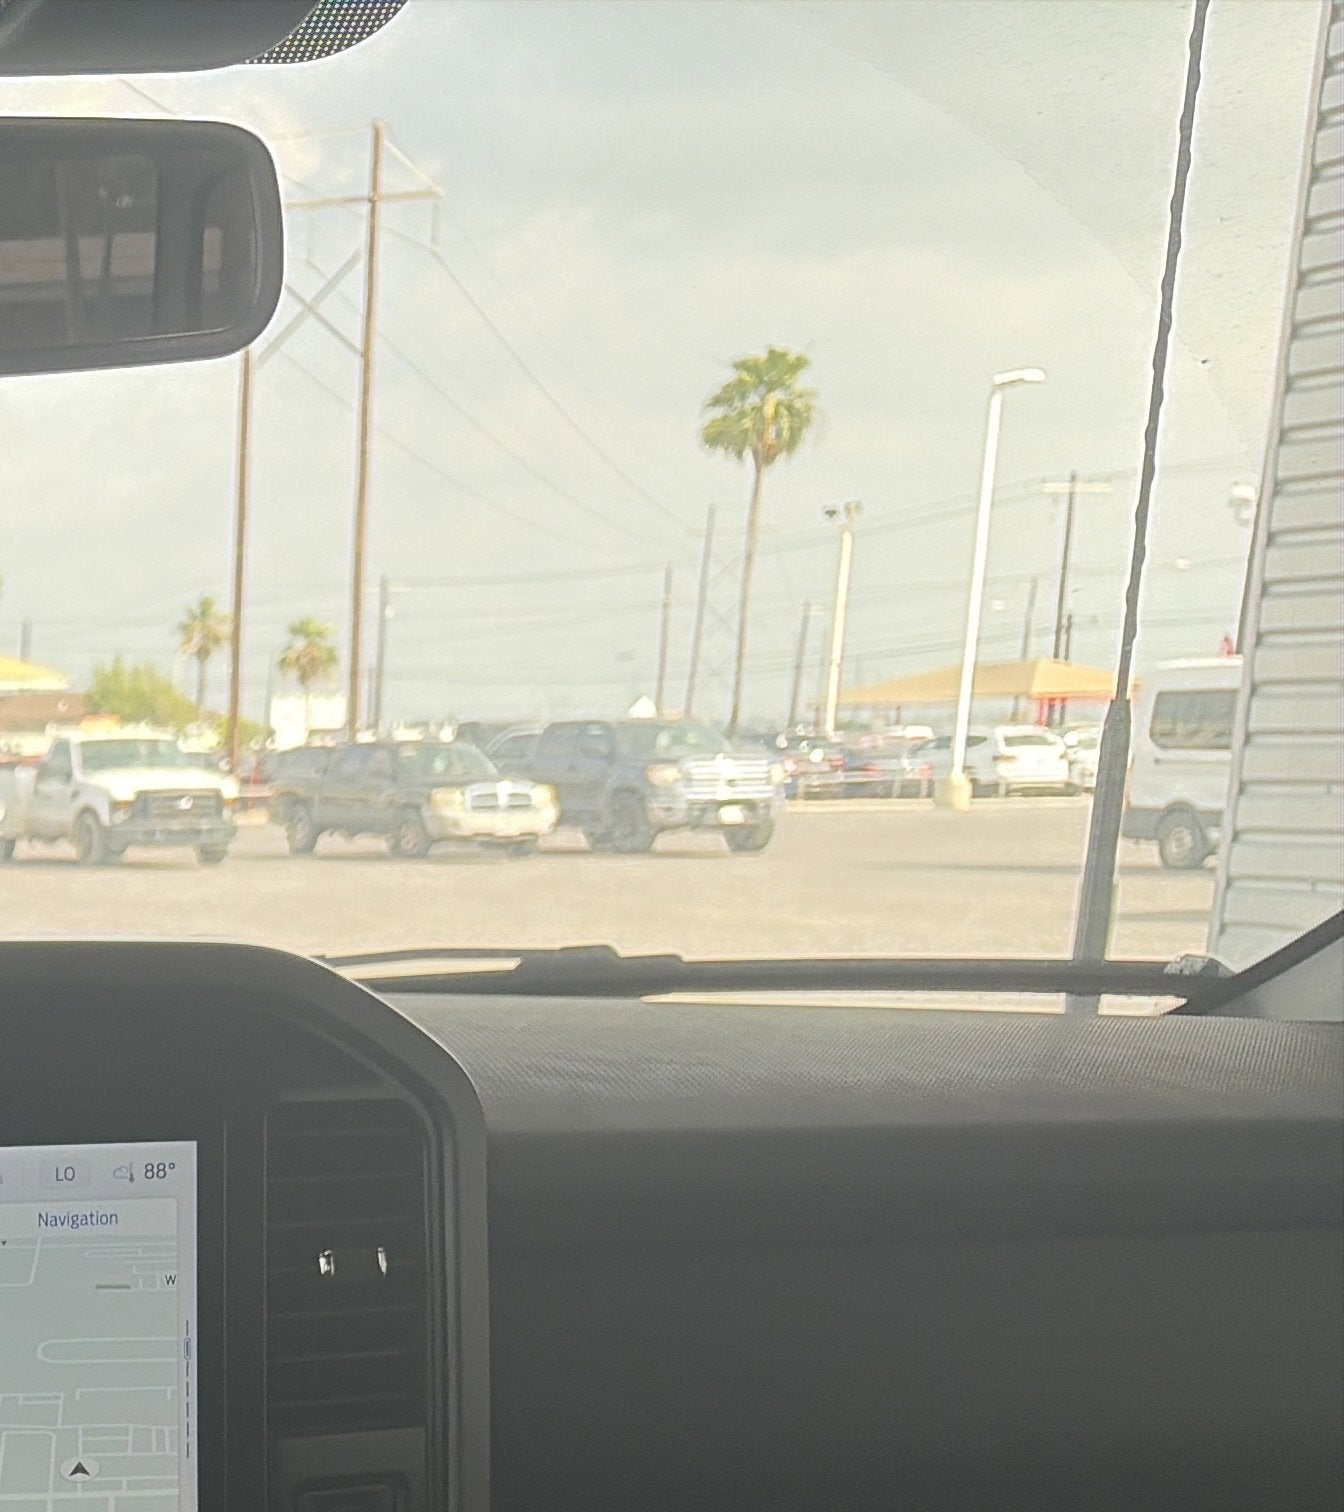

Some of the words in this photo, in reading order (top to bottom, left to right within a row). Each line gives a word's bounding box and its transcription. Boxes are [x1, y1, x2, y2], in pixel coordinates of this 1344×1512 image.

[55, 1167, 76, 1183] LO
[144, 1162, 176, 1180] 88°
[38, 1211, 119, 1229] Navigation
